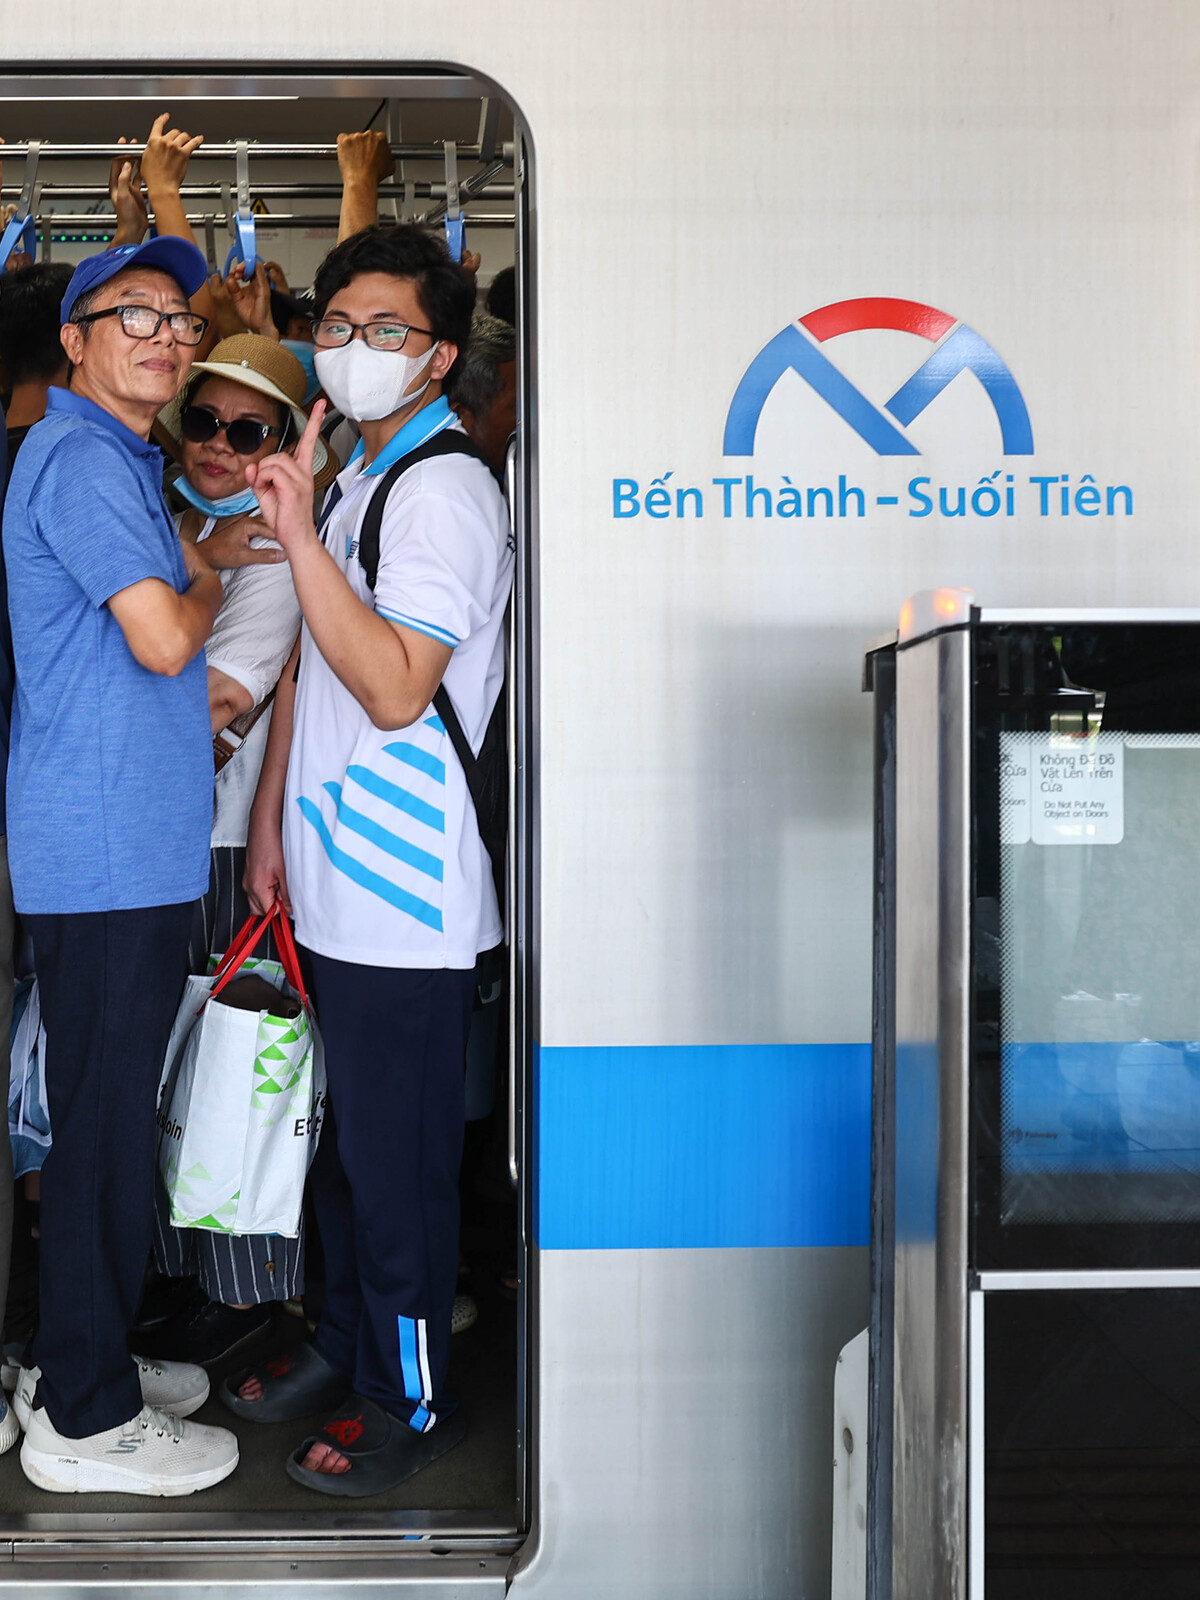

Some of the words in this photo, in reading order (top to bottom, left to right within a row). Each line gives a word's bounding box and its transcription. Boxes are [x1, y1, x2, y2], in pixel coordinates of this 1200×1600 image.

[613, 472, 703, 518] Bến
[713, 475, 865, 518] Thành
[908, 470, 1014, 517] Suối
[1030, 474, 1133, 516] Tiên
[1040, 753, 1075, 767] Không
[1080, 753, 1096, 765] Đ
